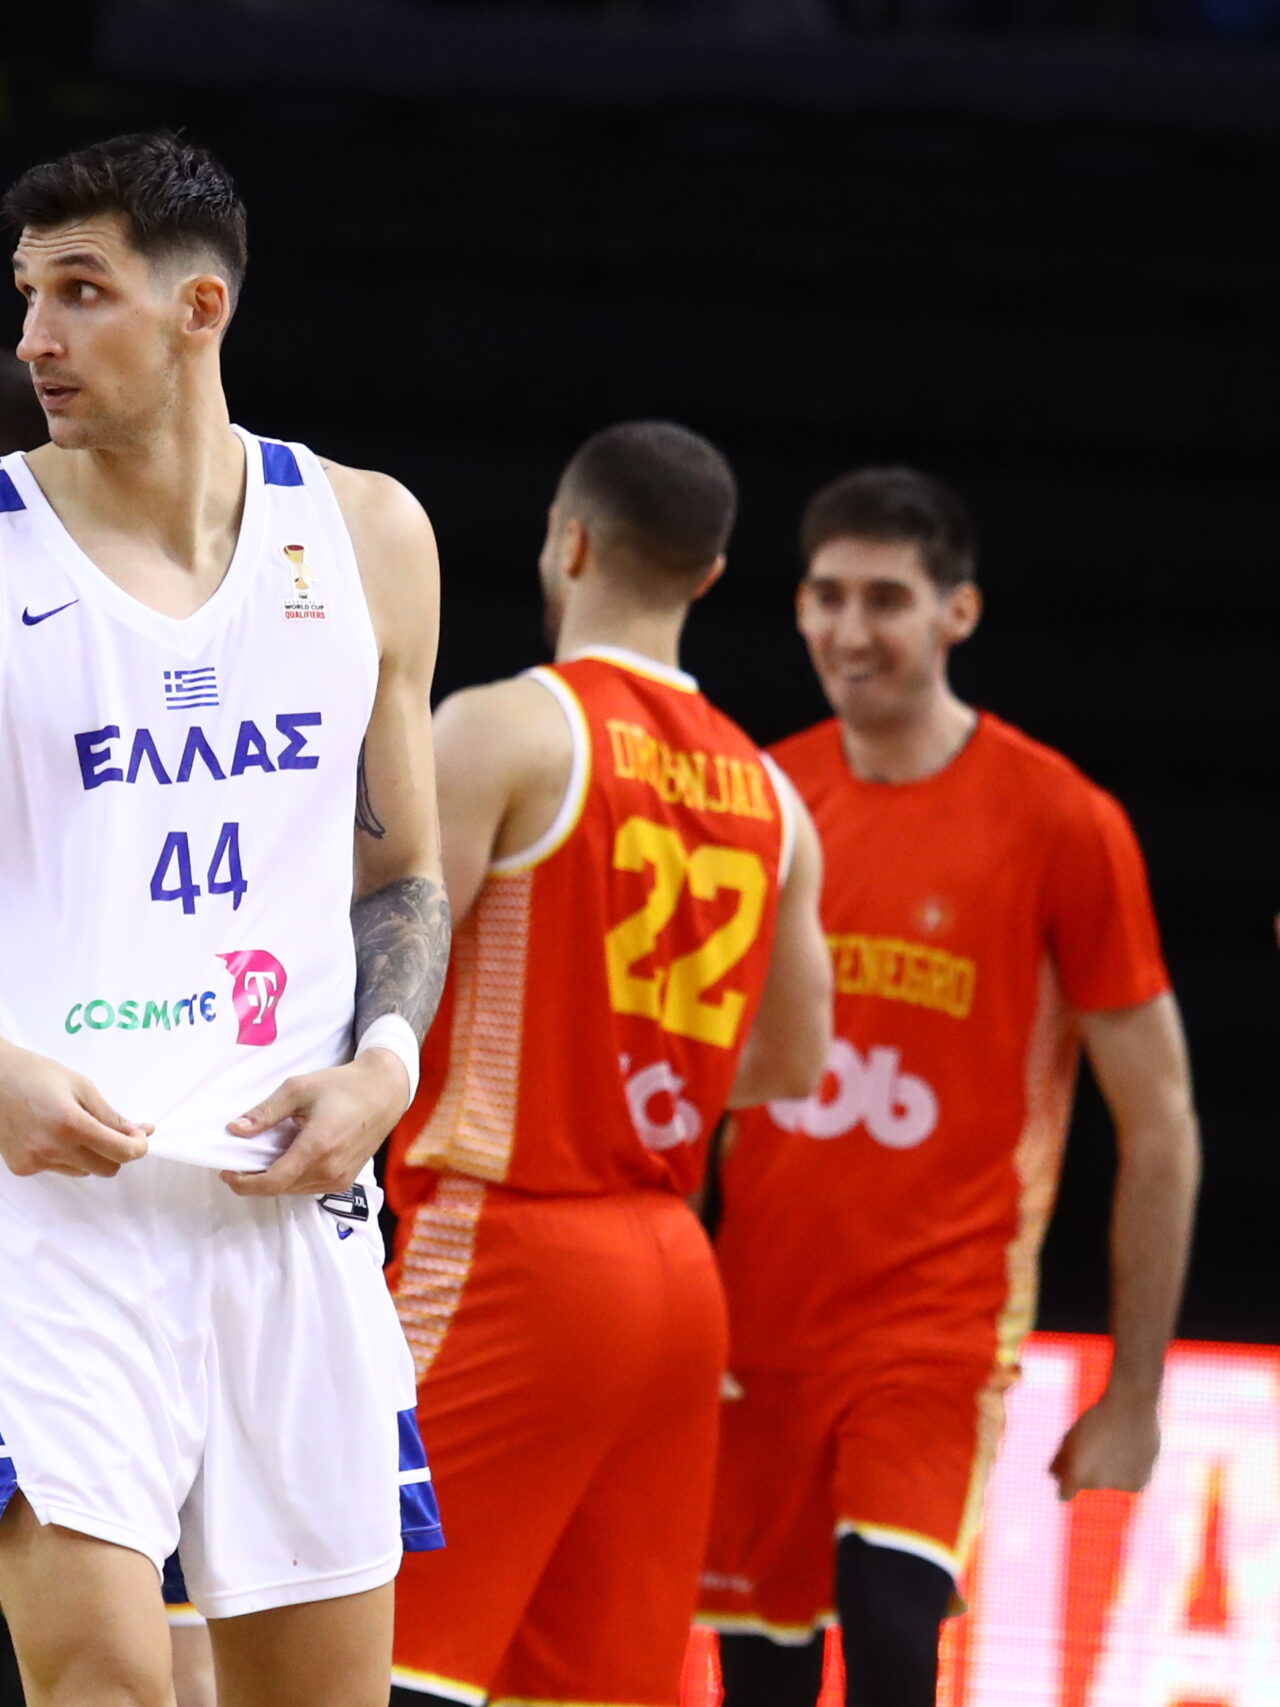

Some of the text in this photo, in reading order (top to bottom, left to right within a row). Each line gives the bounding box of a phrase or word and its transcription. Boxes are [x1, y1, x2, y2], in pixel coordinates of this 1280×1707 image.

[284, 611, 326, 619] QUALIFIERS
[74, 711, 322, 790] ΕΛΛΑΣ
[150, 822, 248, 915] 44
[604, 815, 768, 1050] 22
[767, 1036, 939, 1150] ob
